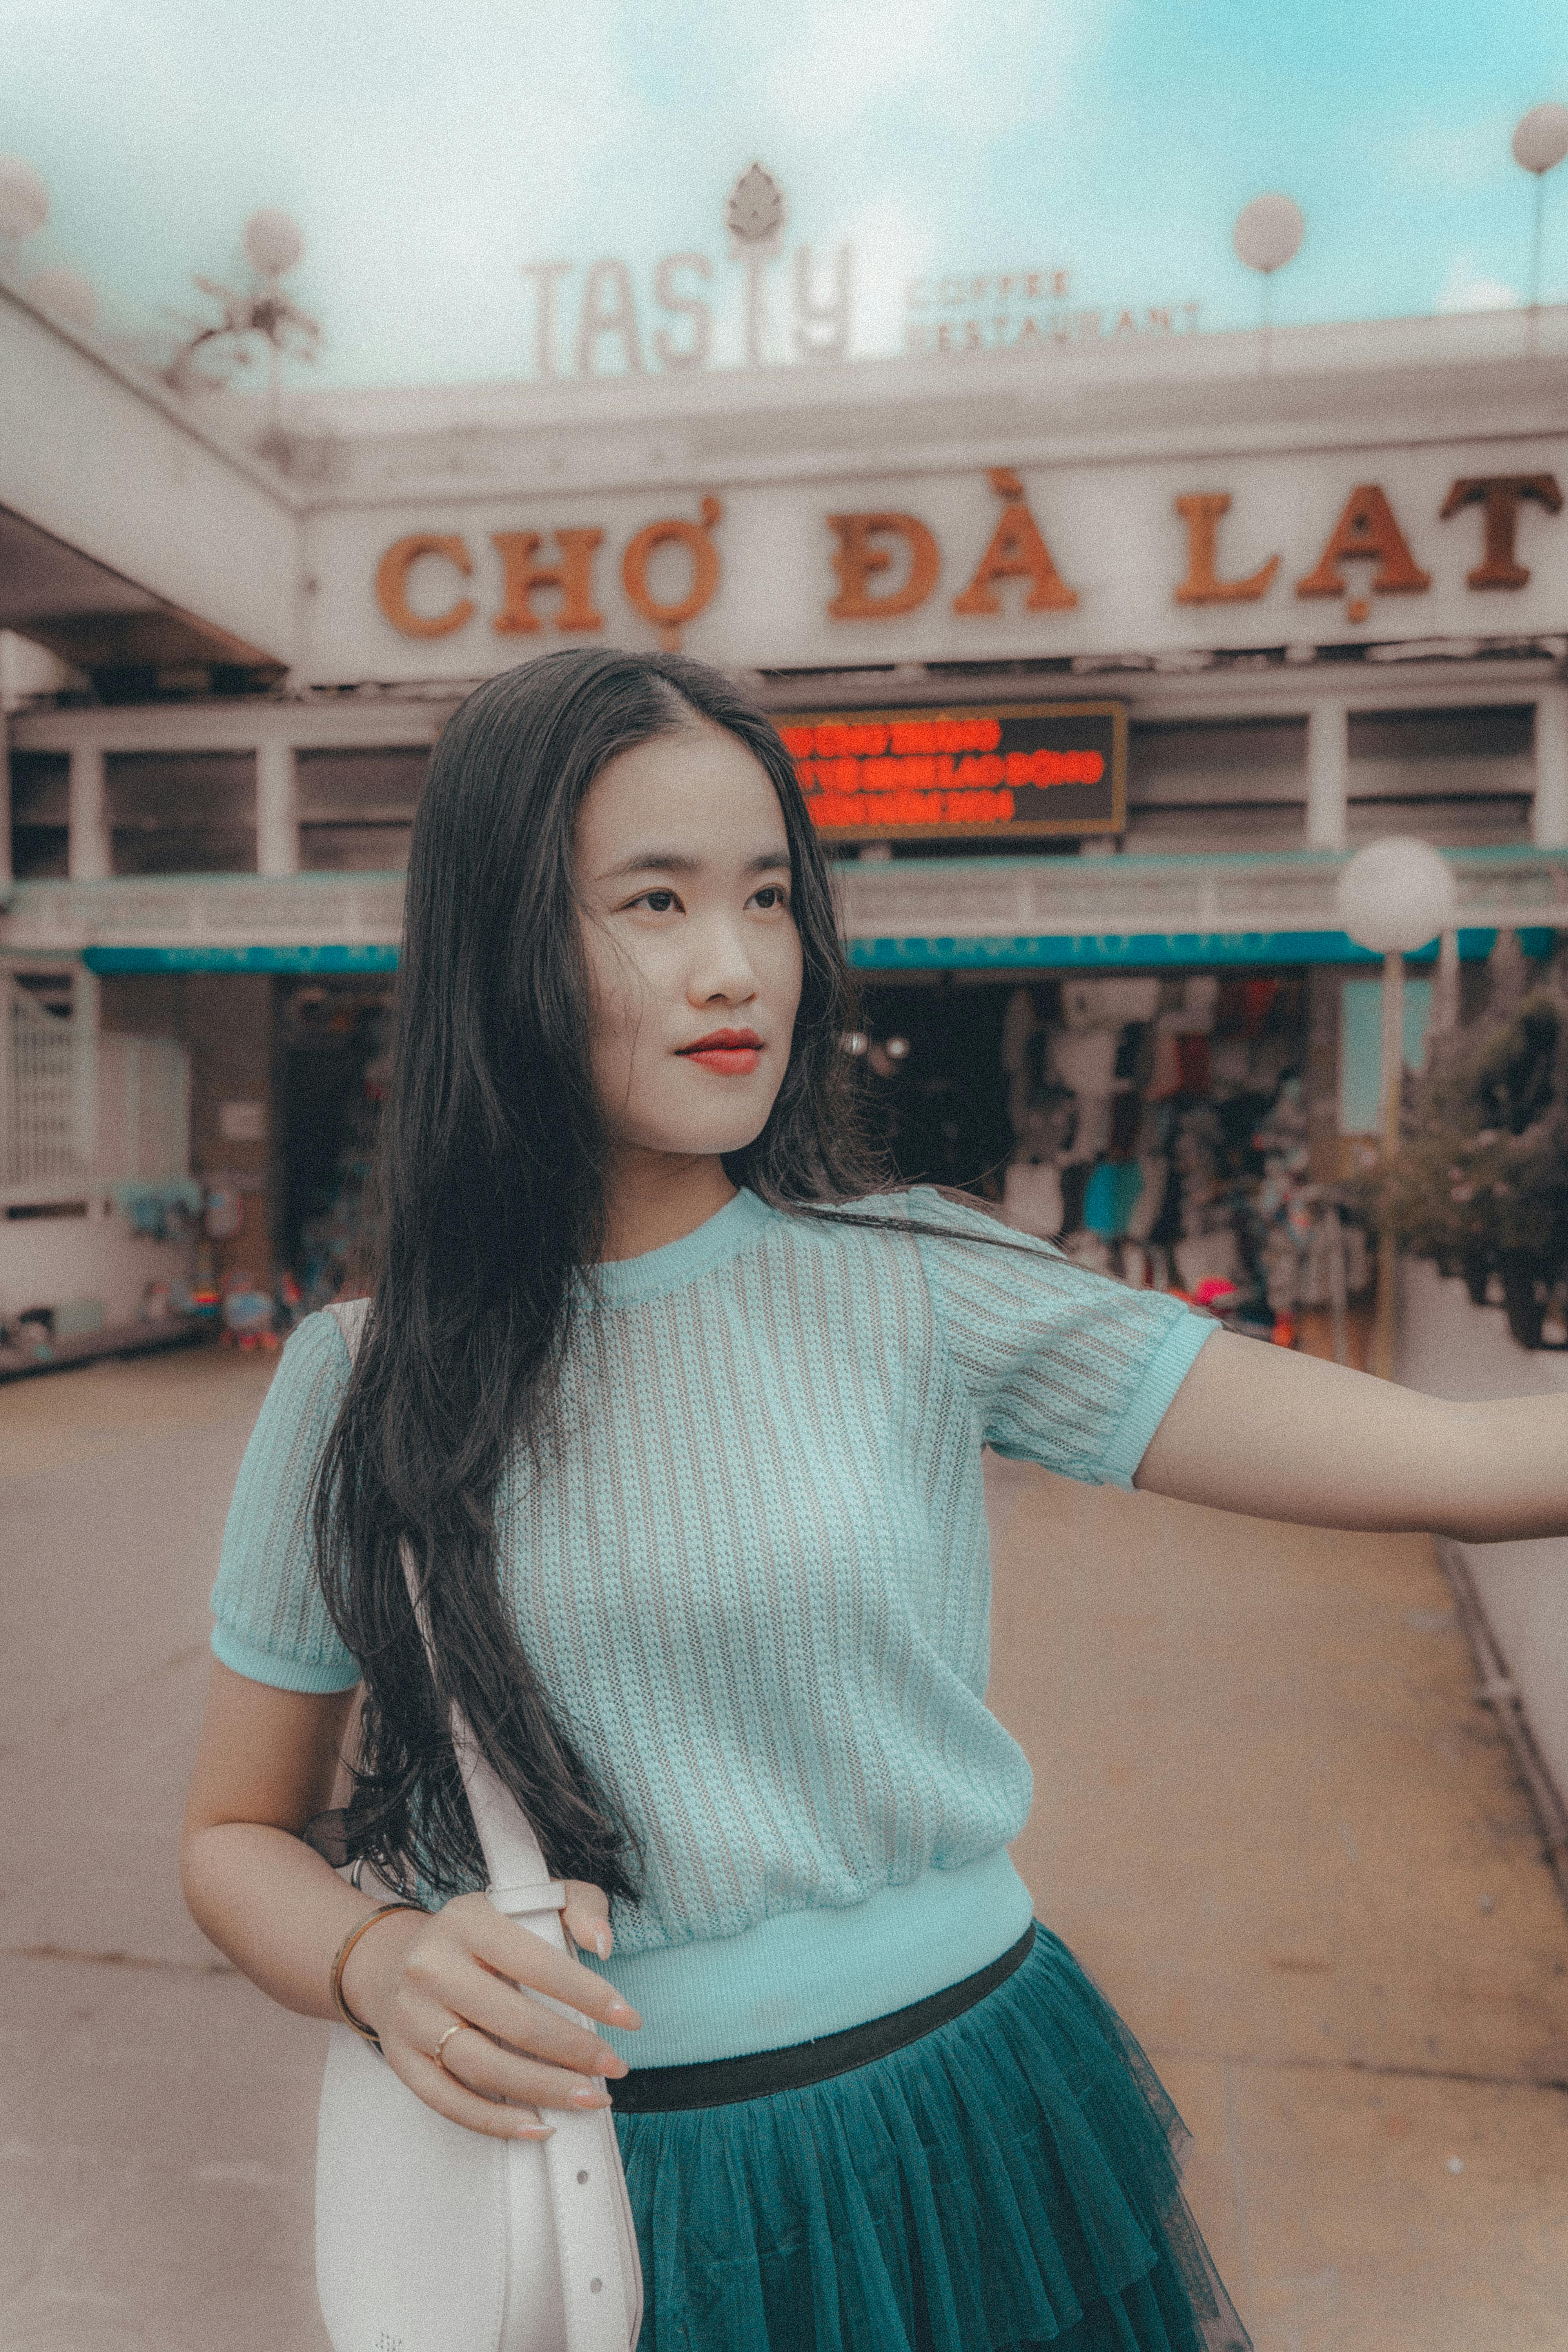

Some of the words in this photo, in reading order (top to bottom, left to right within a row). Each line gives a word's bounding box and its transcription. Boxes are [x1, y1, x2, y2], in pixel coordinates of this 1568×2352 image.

[520, 244, 851, 376] TASTY
[376, 495, 722, 652] CHỢ
[825, 466, 1079, 620] ĐÀ
[1174, 474, 1564, 624] LẠT
